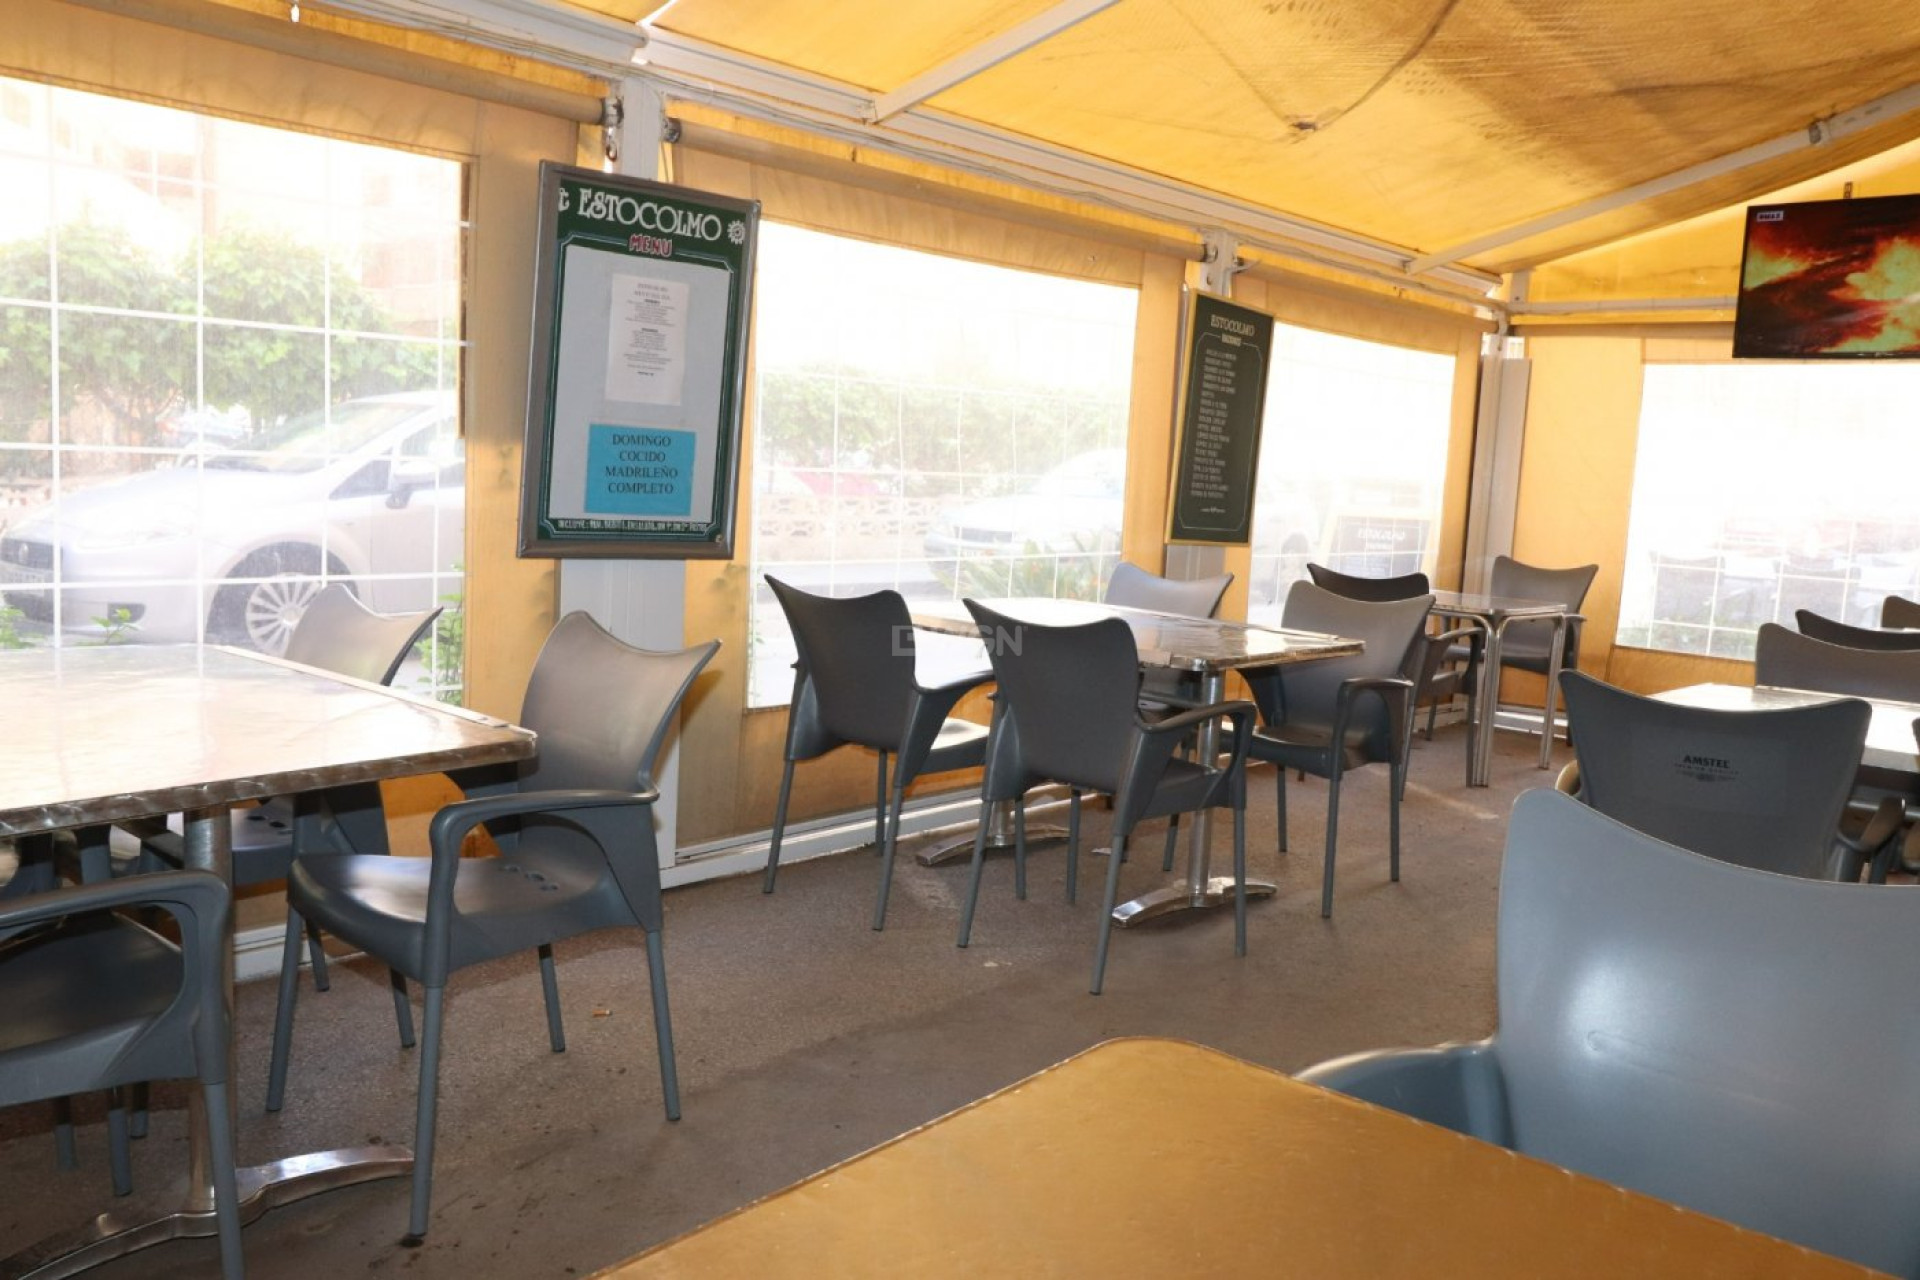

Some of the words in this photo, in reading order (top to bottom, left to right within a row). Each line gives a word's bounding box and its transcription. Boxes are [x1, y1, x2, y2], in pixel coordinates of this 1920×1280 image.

[577, 188, 722, 241] ESTOCOLMO
[1211, 314, 1255, 337] ESTOCOLMO
[612, 433, 671, 447] DOMINGO
[619, 450, 666, 462] COCIDO
[605, 465, 678, 479] MADRILEÑO
[608, 482, 674, 495] COMPLETO
[1683, 754, 1730, 769] AMSTEL
